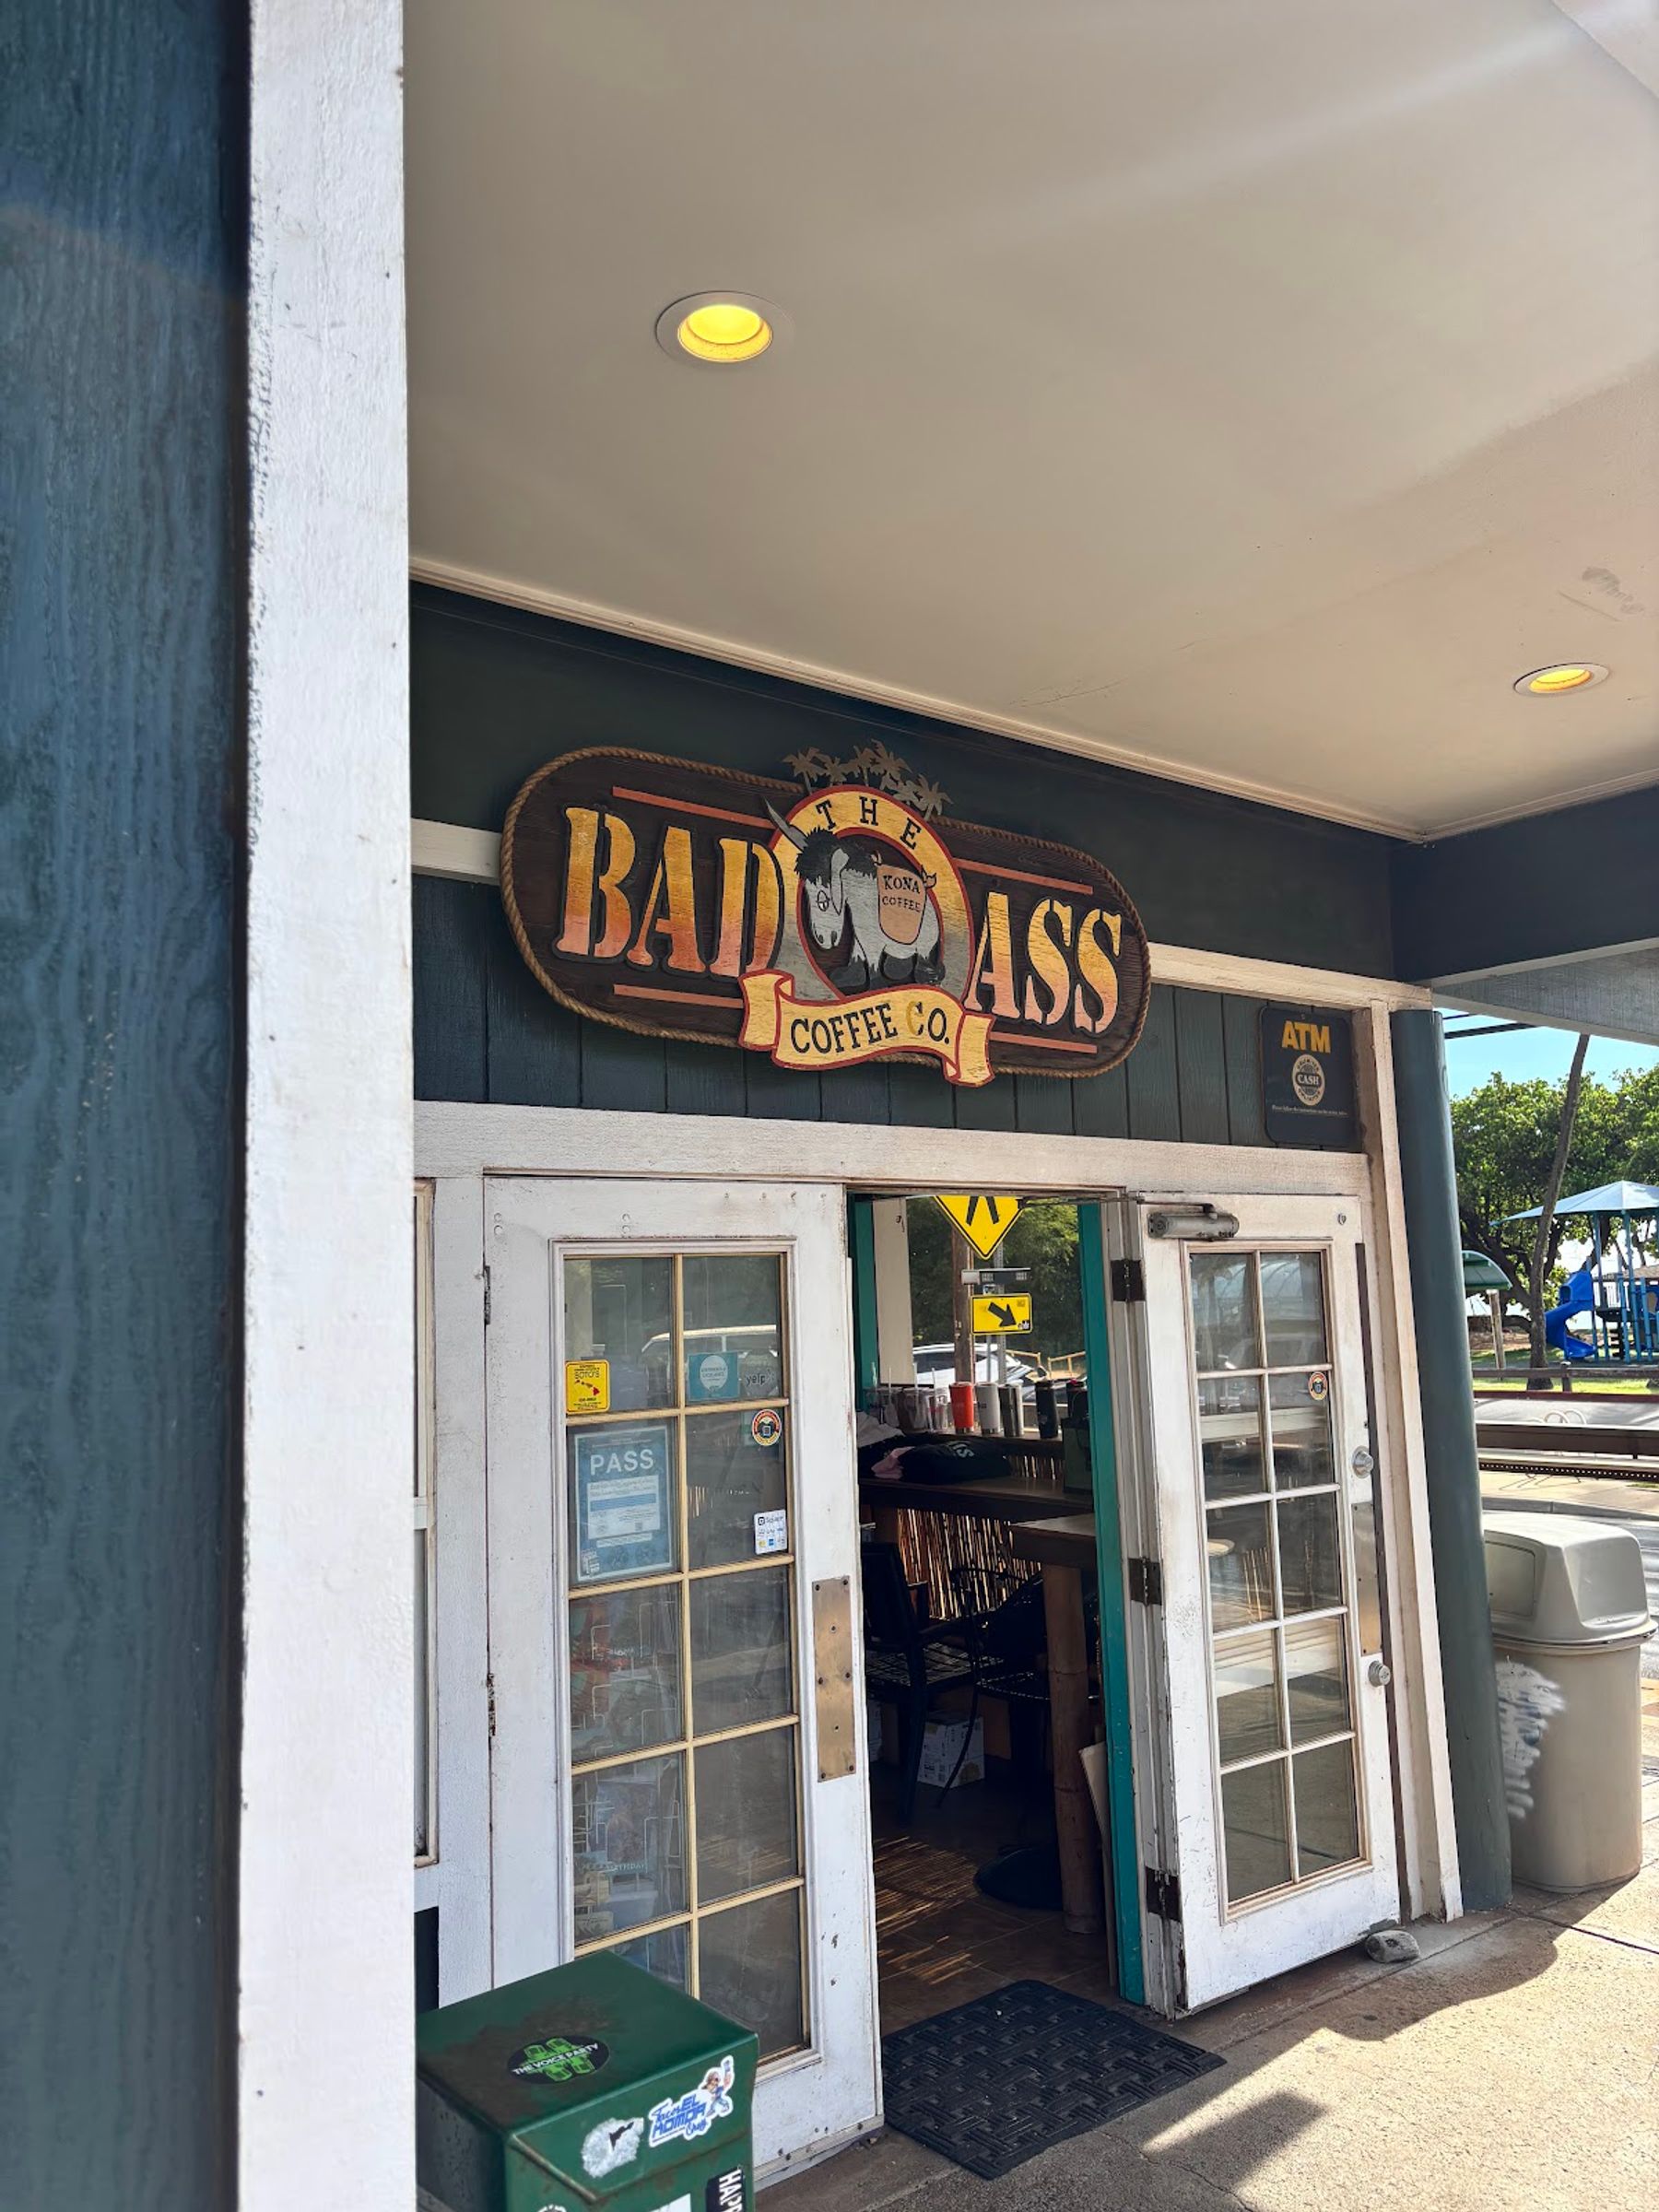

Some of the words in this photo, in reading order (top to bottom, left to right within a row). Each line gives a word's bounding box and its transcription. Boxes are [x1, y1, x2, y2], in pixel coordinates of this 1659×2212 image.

[816, 795, 922, 850] THE
[883, 875, 921, 894] KONA
[882, 895, 921, 912] COFFEE
[555, 806, 782, 978] BAD
[964, 891, 1122, 1034] ASS
[790, 1002, 899, 1054] COFFEE
[905, 1000, 950, 1045] CO.
[1281, 1019, 1332, 1053] ATM
[1297, 1074, 1320, 1085] CASH
[746, 1372, 766, 1387] yelp
[591, 1449, 654, 1476] PASS
[512, 2064, 534, 2076] THE
[533, 2053, 566, 2067] VOICE
[565, 2042, 599, 2058] PARTY
